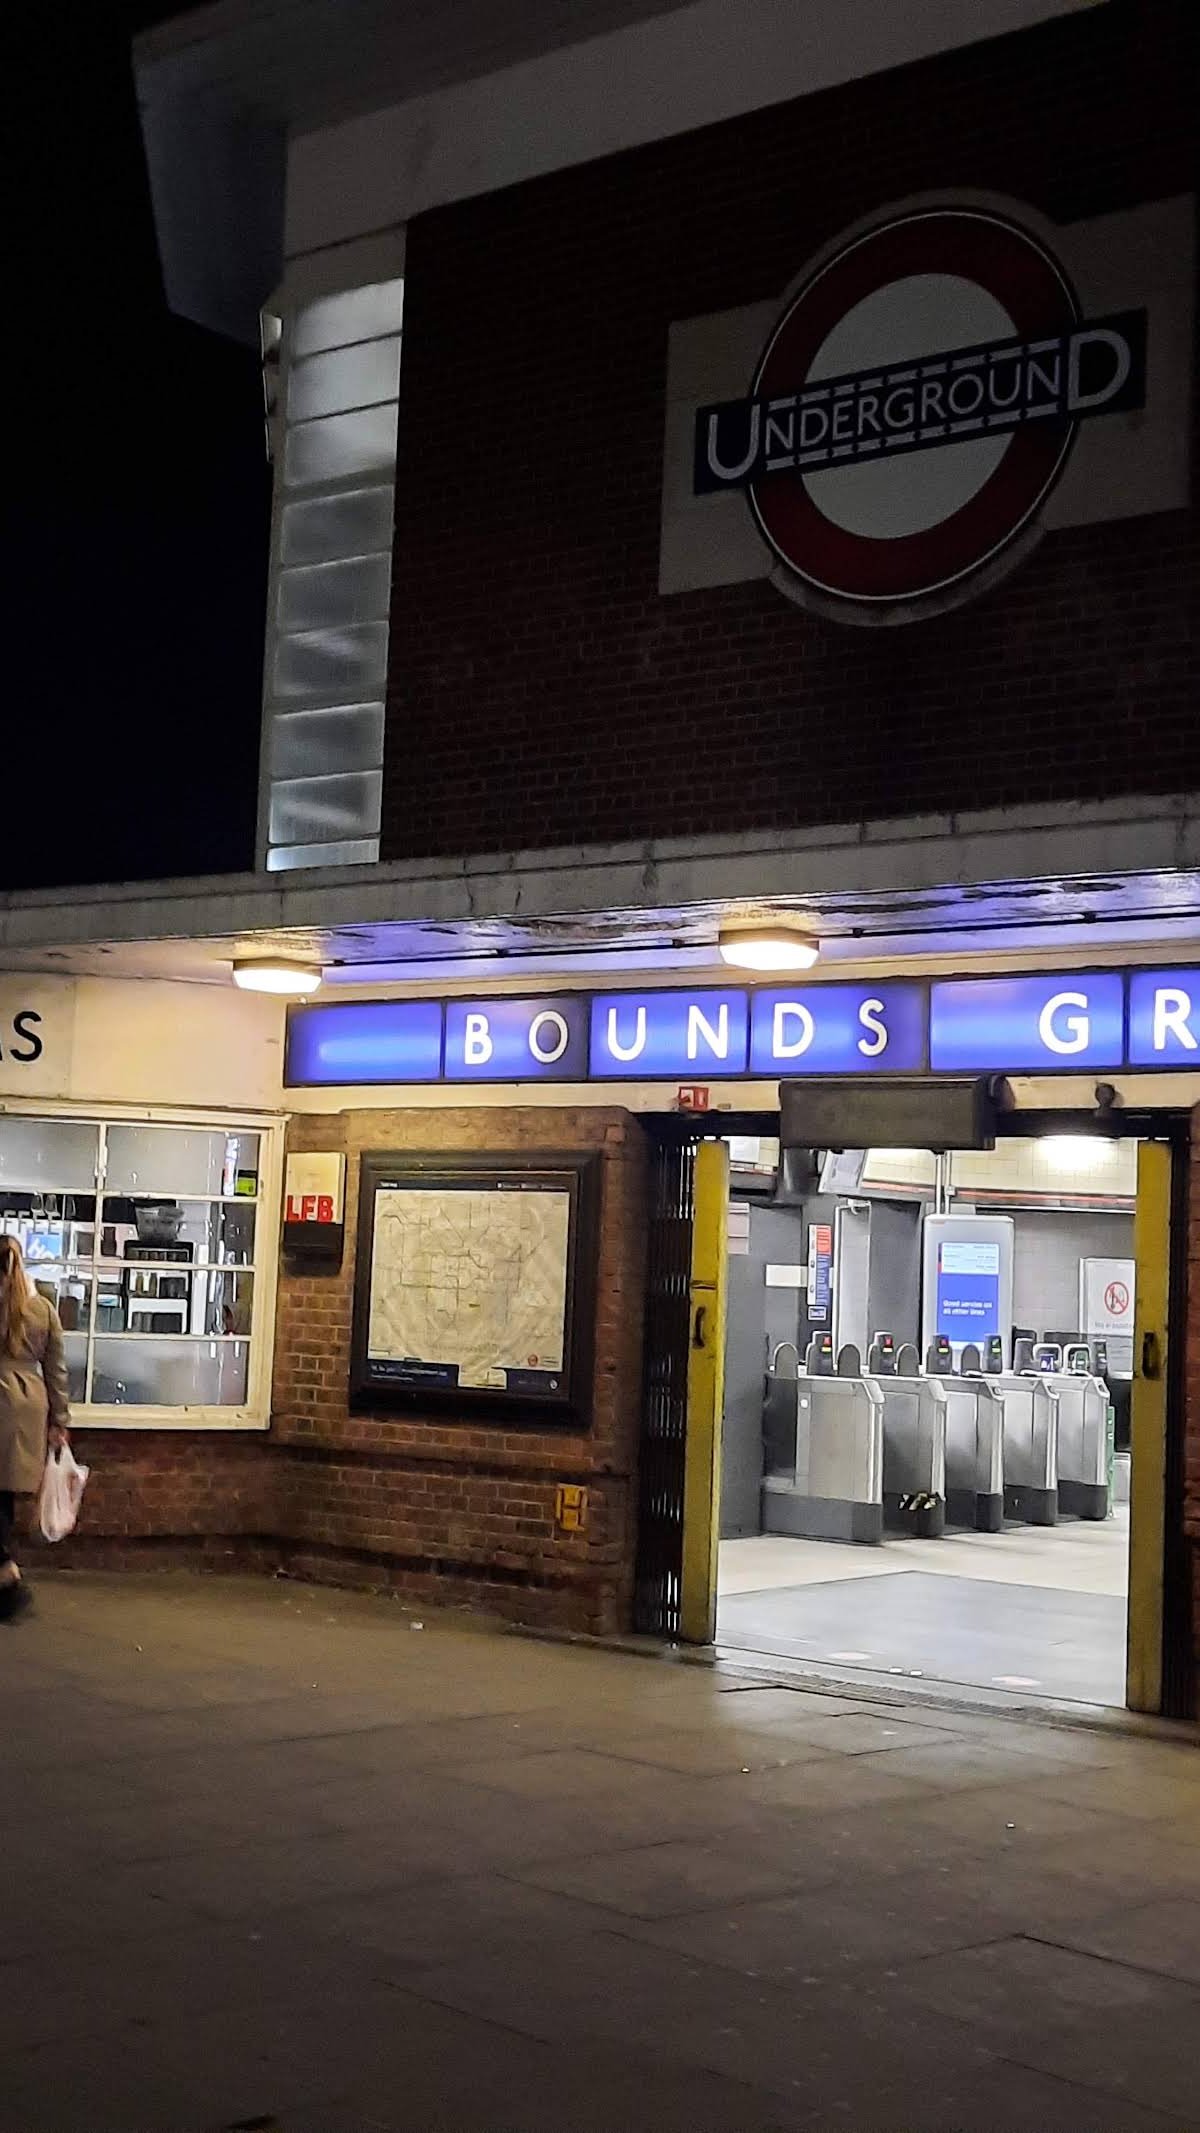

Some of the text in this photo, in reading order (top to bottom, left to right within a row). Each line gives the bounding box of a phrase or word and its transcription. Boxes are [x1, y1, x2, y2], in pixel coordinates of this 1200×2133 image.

[707, 328, 1132, 480] UNDERGROUND
[0, 1010, 43, 1062] S
[463, 997, 889, 1065] BOUNDS
[286, 1194, 334, 1223] LFB
